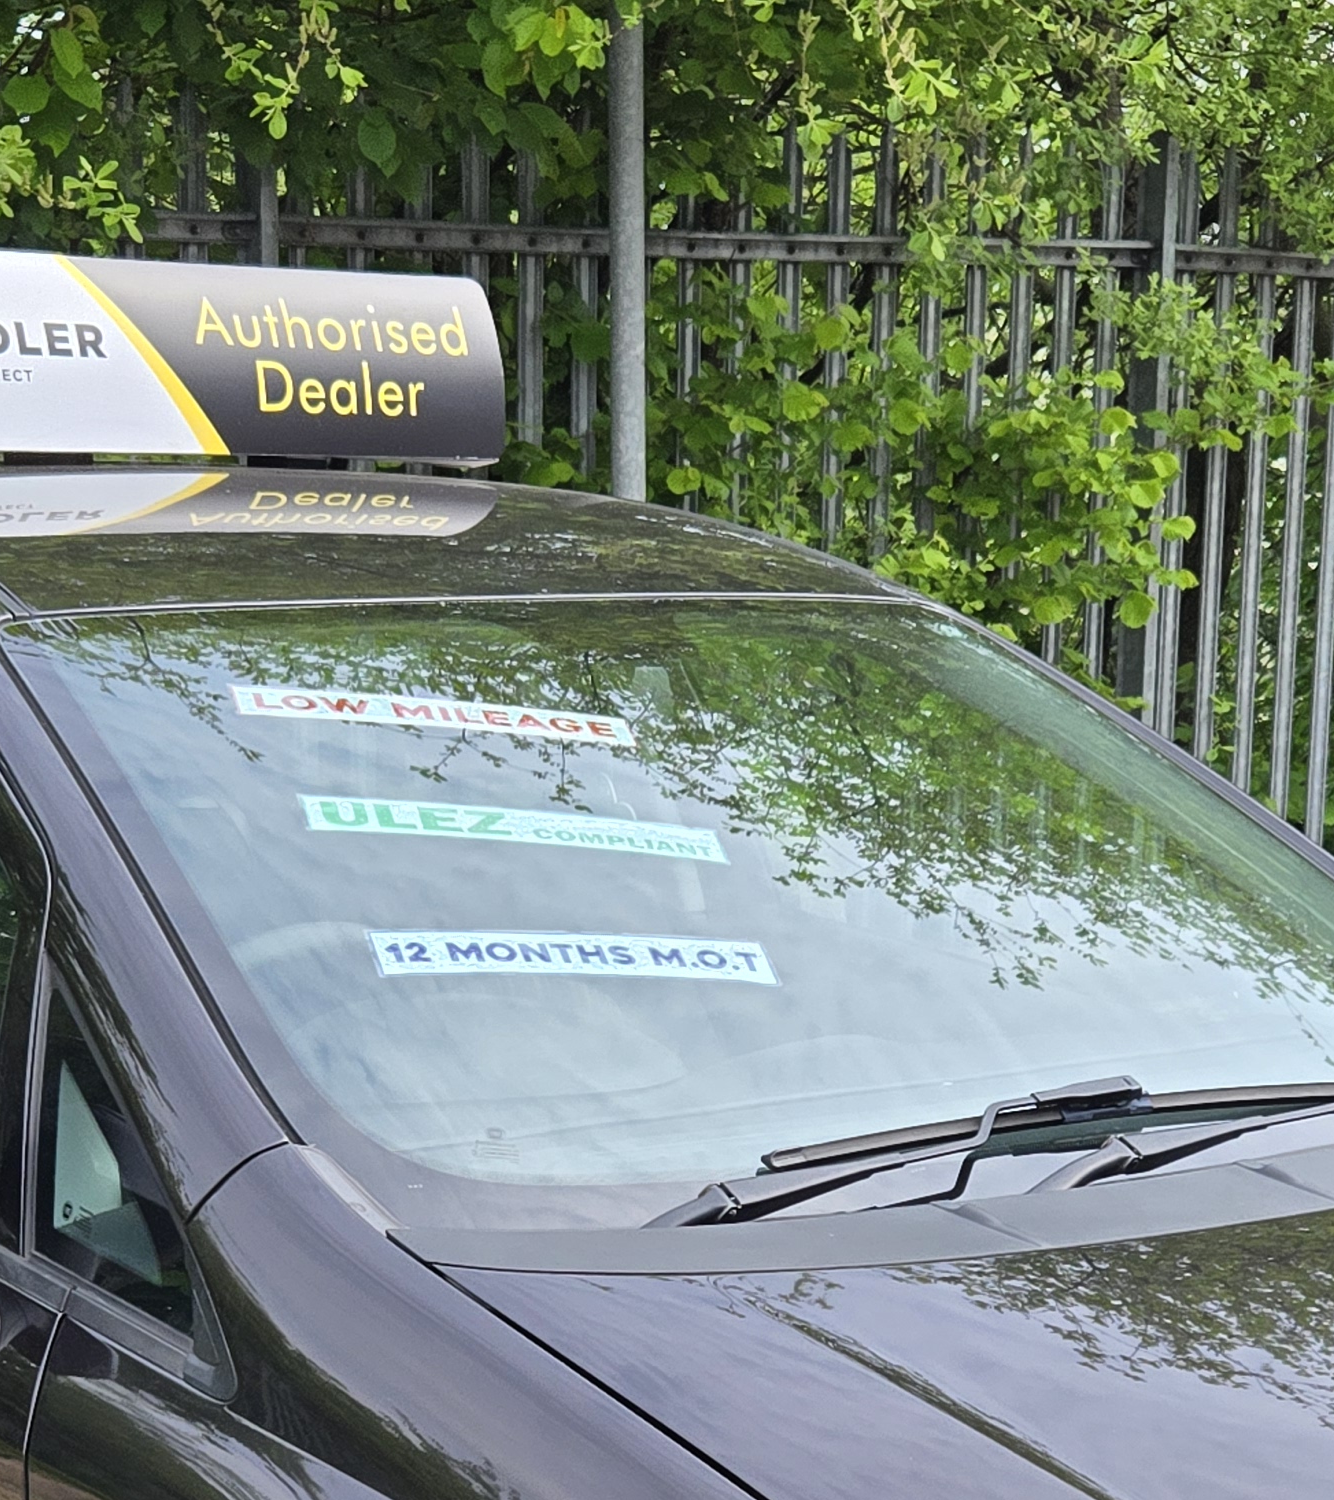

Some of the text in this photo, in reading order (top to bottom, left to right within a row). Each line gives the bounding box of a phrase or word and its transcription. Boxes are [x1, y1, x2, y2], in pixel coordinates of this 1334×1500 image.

[195, 296, 470, 357] Authorised
[254, 360, 426, 417] Dealer
[251, 692, 618, 740] LOW MILEAGE
[319, 799, 715, 859] ULEZ COMPLIANT
[384, 941, 761, 974] 12 MONTHS M.O.T
